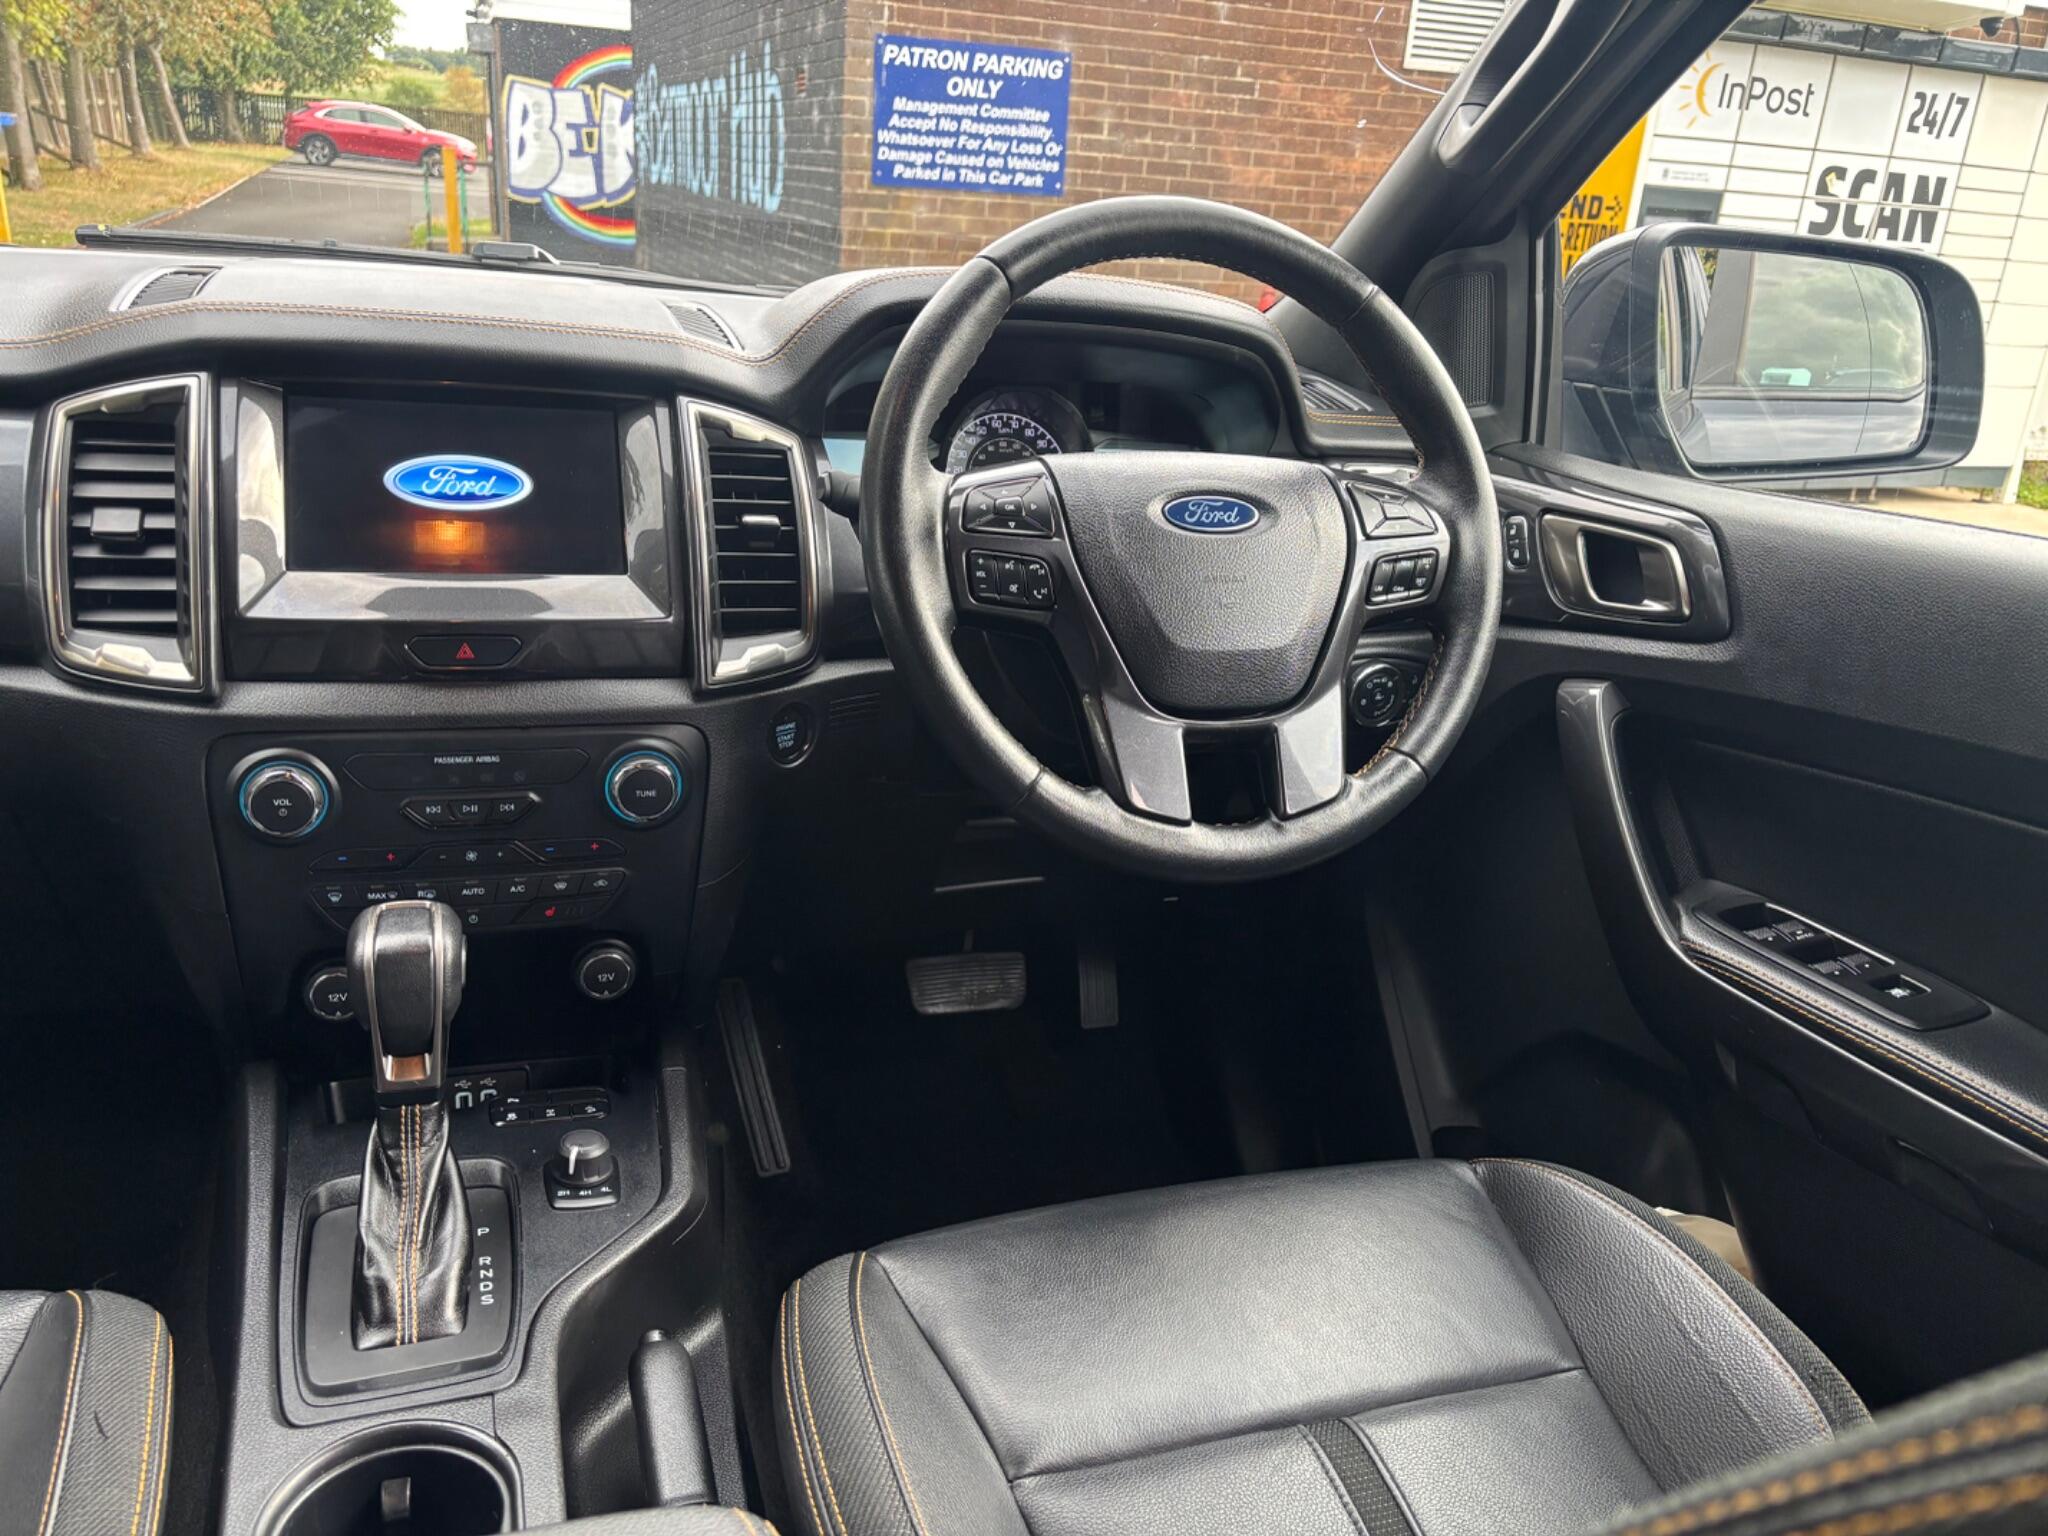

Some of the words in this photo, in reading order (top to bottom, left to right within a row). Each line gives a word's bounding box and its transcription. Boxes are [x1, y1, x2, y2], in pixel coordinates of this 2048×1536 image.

[882, 44, 969, 72] PATRON
[972, 52, 1064, 80] PARKING
[946, 76, 1004, 99] ONLY
[1718, 73, 1815, 117] InPost
[892, 96, 978, 117] Management
[980, 102, 1051, 123] Committee
[1906, 91, 1970, 139] 24/7
[888, 112, 937, 133] Accept
[938, 116, 959, 132] No
[960, 118, 1053, 142] Responsibility
[877, 130, 957, 149] Whatsoever
[957, 134, 982, 150] For
[982, 136, 1010, 155] Any
[1011, 139, 1043, 155] Loss
[1045, 141, 1063, 157] Or
[877, 145, 933, 166] Damage
[935, 149, 986, 167] Caused
[1007, 154, 1060, 173] Vehicles
[893, 163, 941, 180] Parked
[958, 168, 987, 185] This
[988, 170, 1013, 185] Car
[1013, 172, 1045, 188] Park
[1807, 165, 1948, 244] SCAN
[422, 465, 497, 497] Ford
[1184, 500, 1240, 523] Ford
[433, 756, 474, 764] PASSENGER
[635, 790, 657, 798] TUNE
[367, 891, 387, 900] MAX
[462, 887, 485, 896] AUTO
[510, 884, 526, 893] A/C
[597, 973, 616, 983] 12V
[328, 993, 348, 1002] 12V
[477, 1227, 490, 1237] P
[479, 1256, 492, 1267] R
[480, 1268, 493, 1279] N
[480, 1281, 493, 1292] D
[481, 1294, 494, 1306] S
